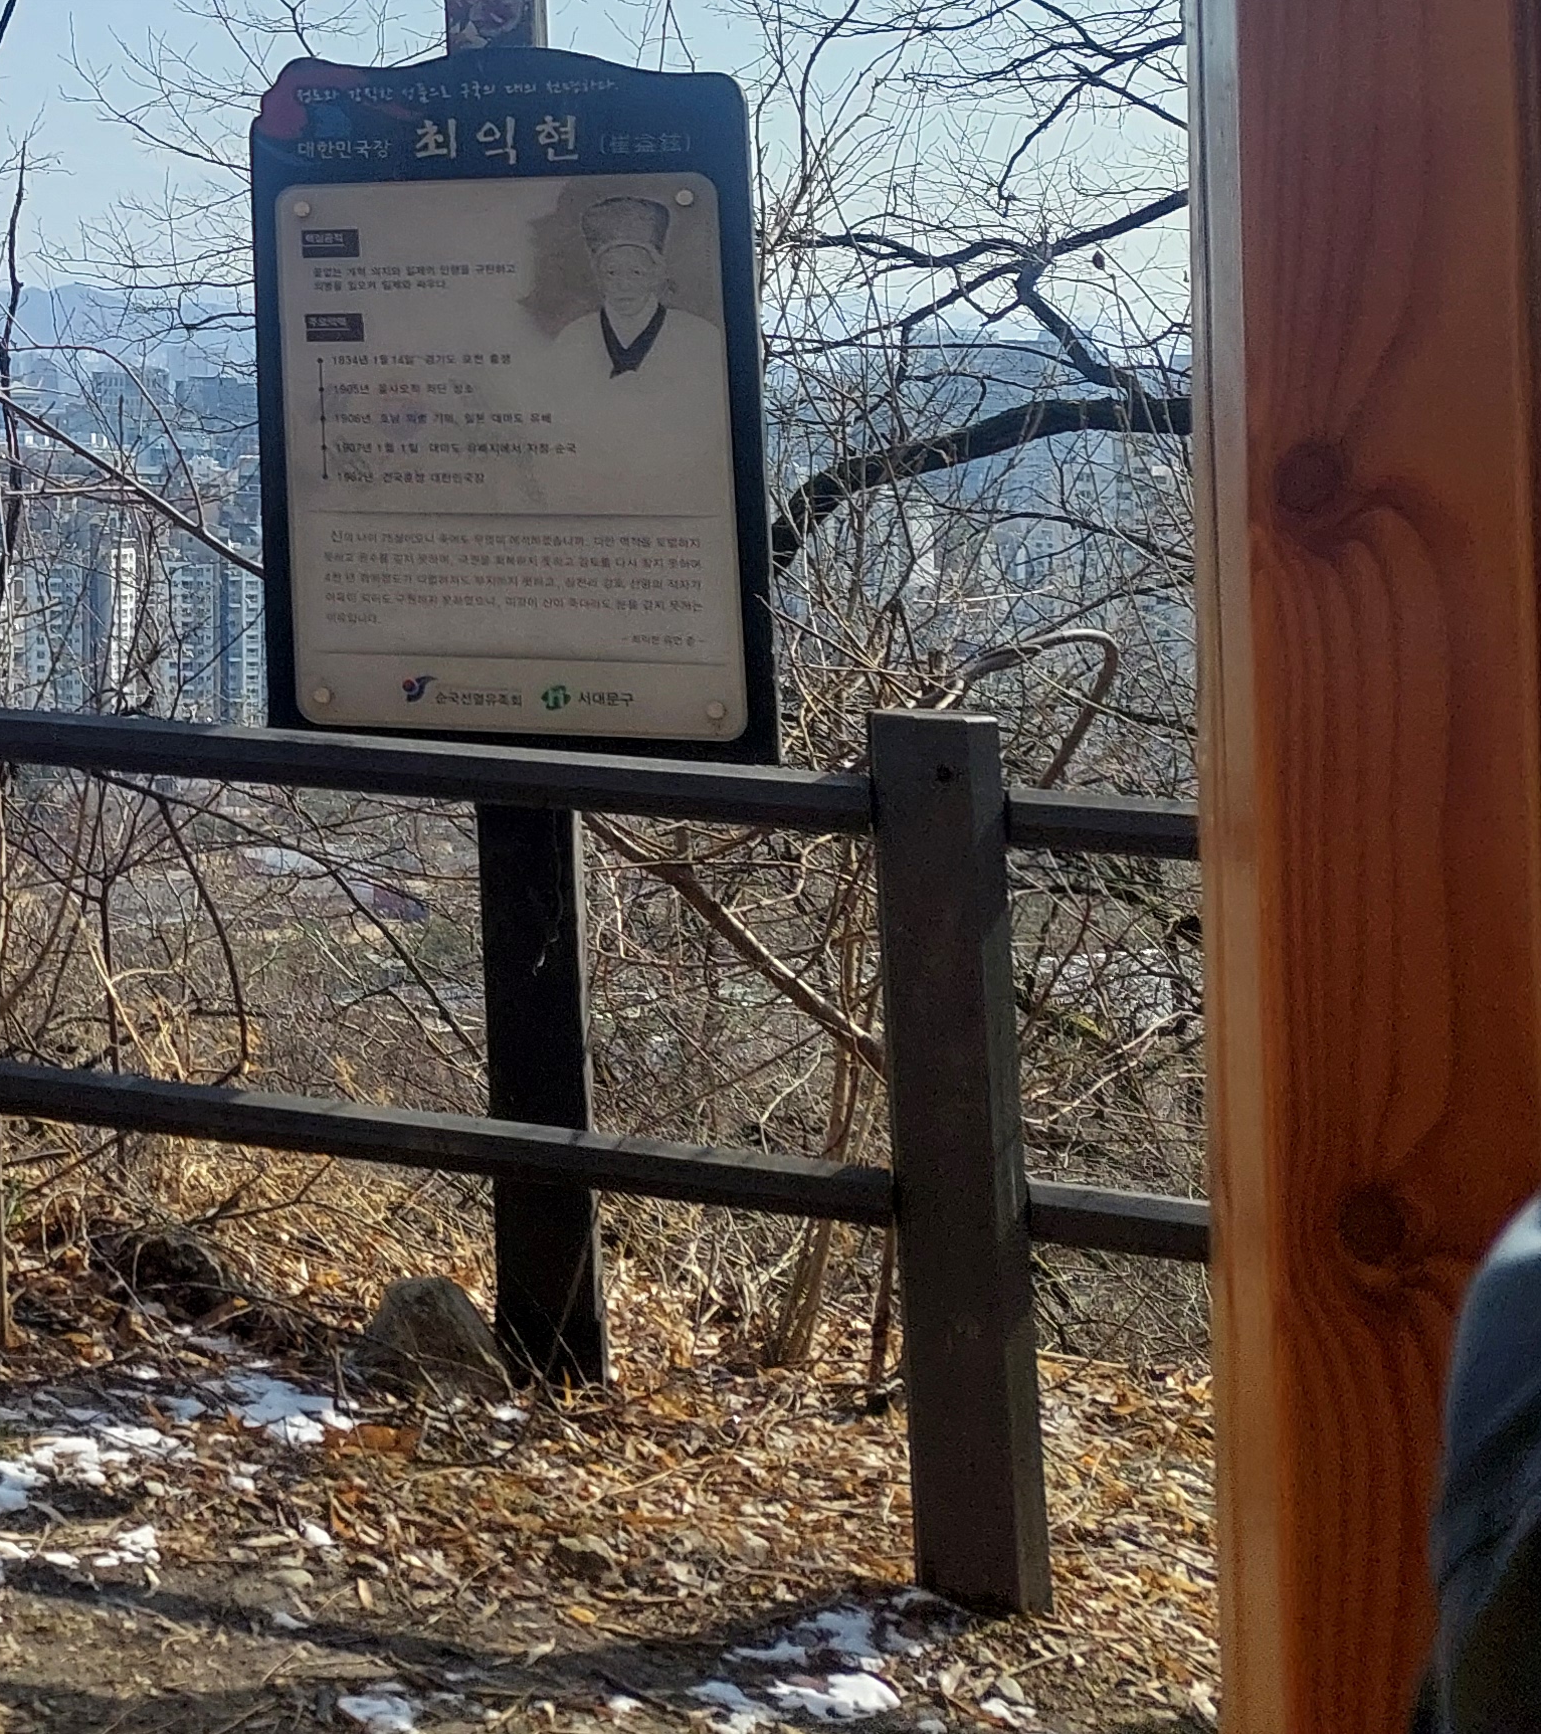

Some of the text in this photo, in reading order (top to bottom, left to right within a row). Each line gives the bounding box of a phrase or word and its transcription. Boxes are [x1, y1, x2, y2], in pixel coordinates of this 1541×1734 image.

[401, 81, 452, 104] 성품으로
[460, 80, 497, 101] 구국의
[503, 81, 538, 95] 대의
[297, 138, 391, 161] 대한민국장
[415, 114, 579, 166] 최익현
[474, 263, 516, 275] 규탄하고
[332, 354, 368, 366] 1834년
[425, 354, 457, 365] 경기도
[490, 354, 512, 365] 출생
[492, 413, 523, 424] 대마도
[429, 442, 460, 454] 대마도
[430, 472, 485, 484] 대한민국장
[357, 533, 378, 543] 나이
[593, 536, 615, 547] 다만
[614, 557, 638, 568] 다시
[435, 691, 634, 707] 순국선열유족회 서대문구
